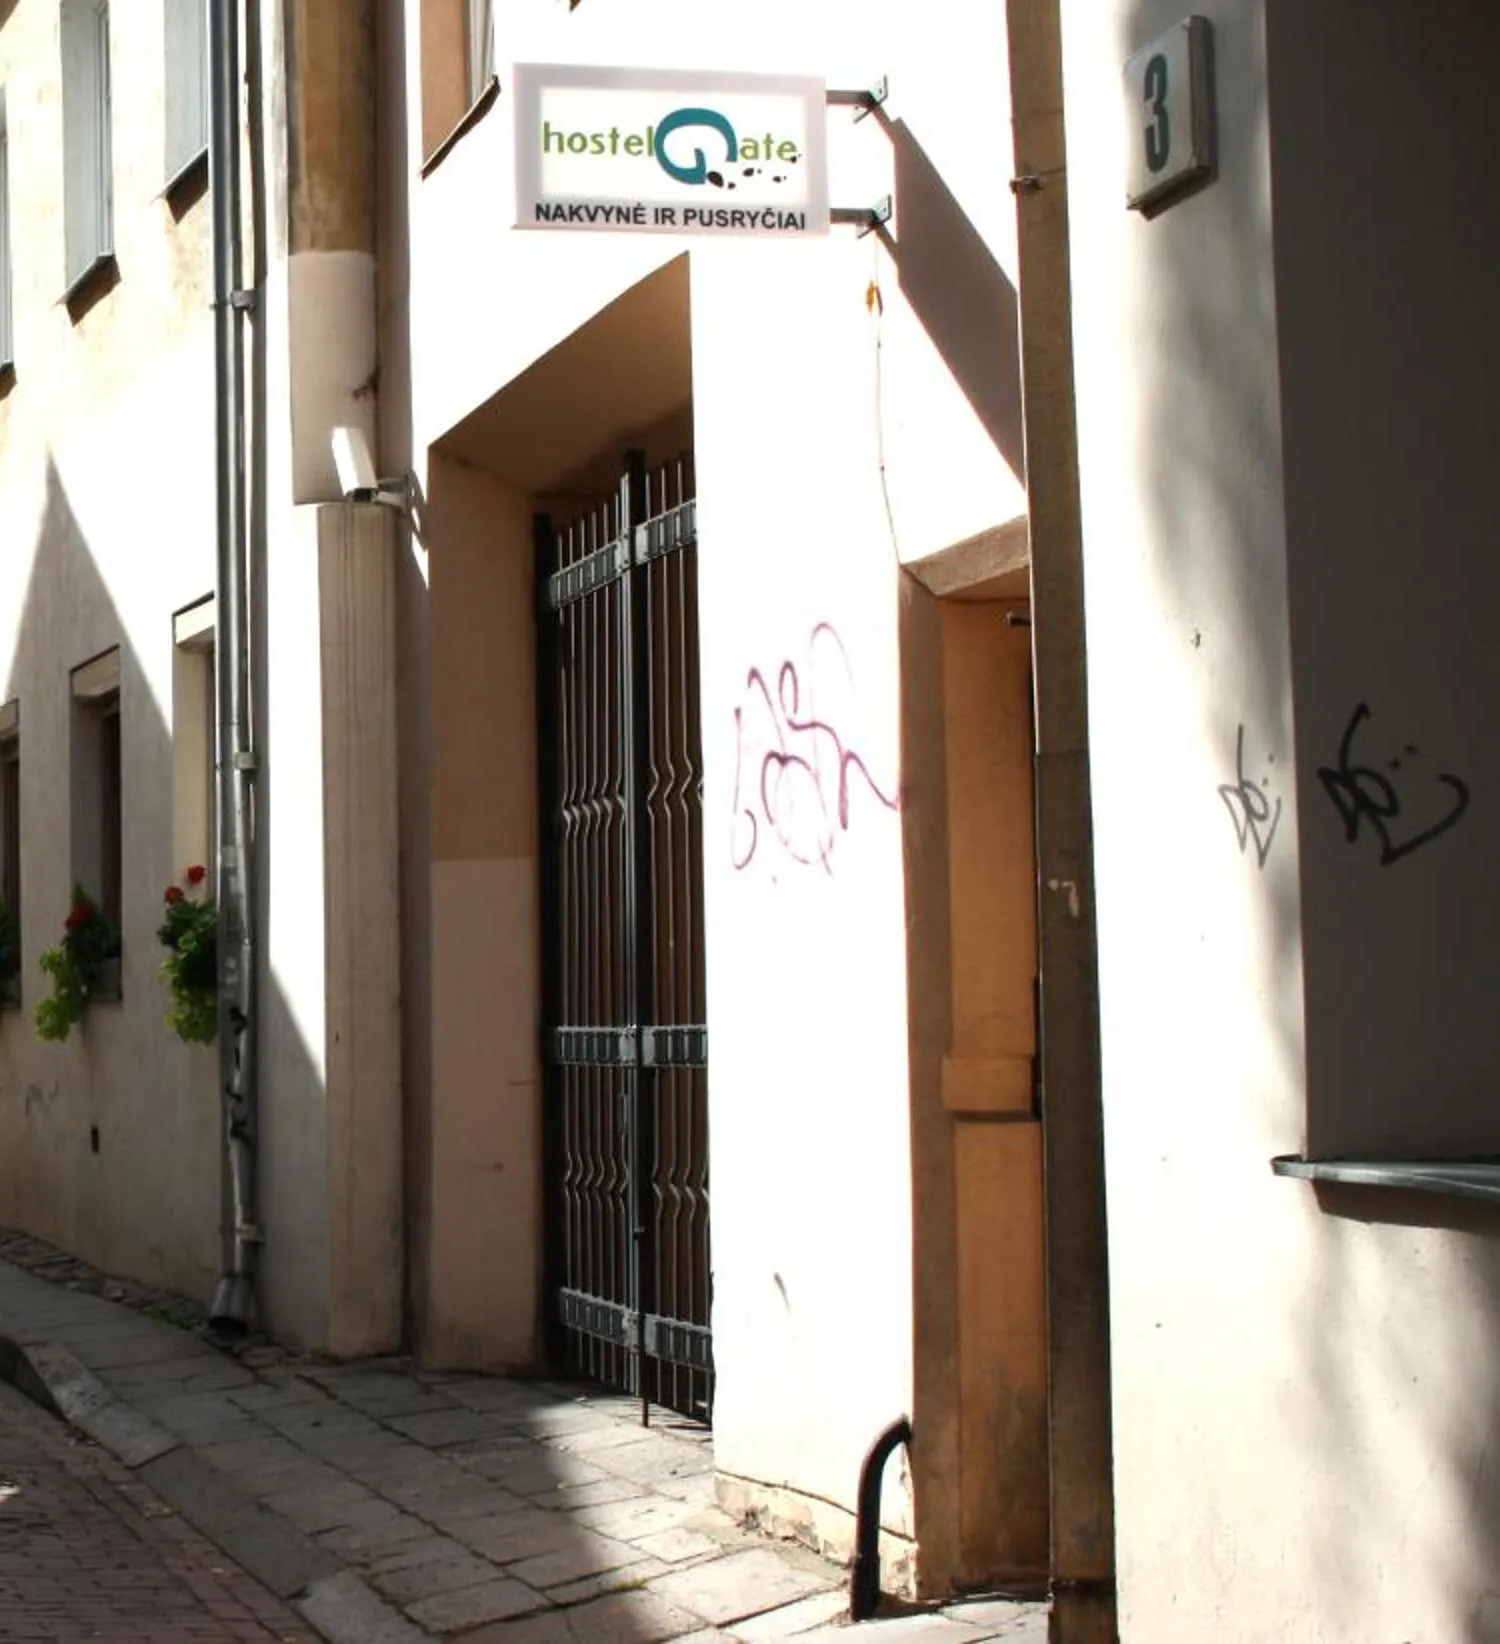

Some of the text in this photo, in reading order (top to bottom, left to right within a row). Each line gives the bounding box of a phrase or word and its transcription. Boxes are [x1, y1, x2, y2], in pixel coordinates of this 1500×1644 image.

[1143, 53, 1170, 174] 3
[535, 202, 805, 231] NAKVYNĖ IR PUSRYČIAI
